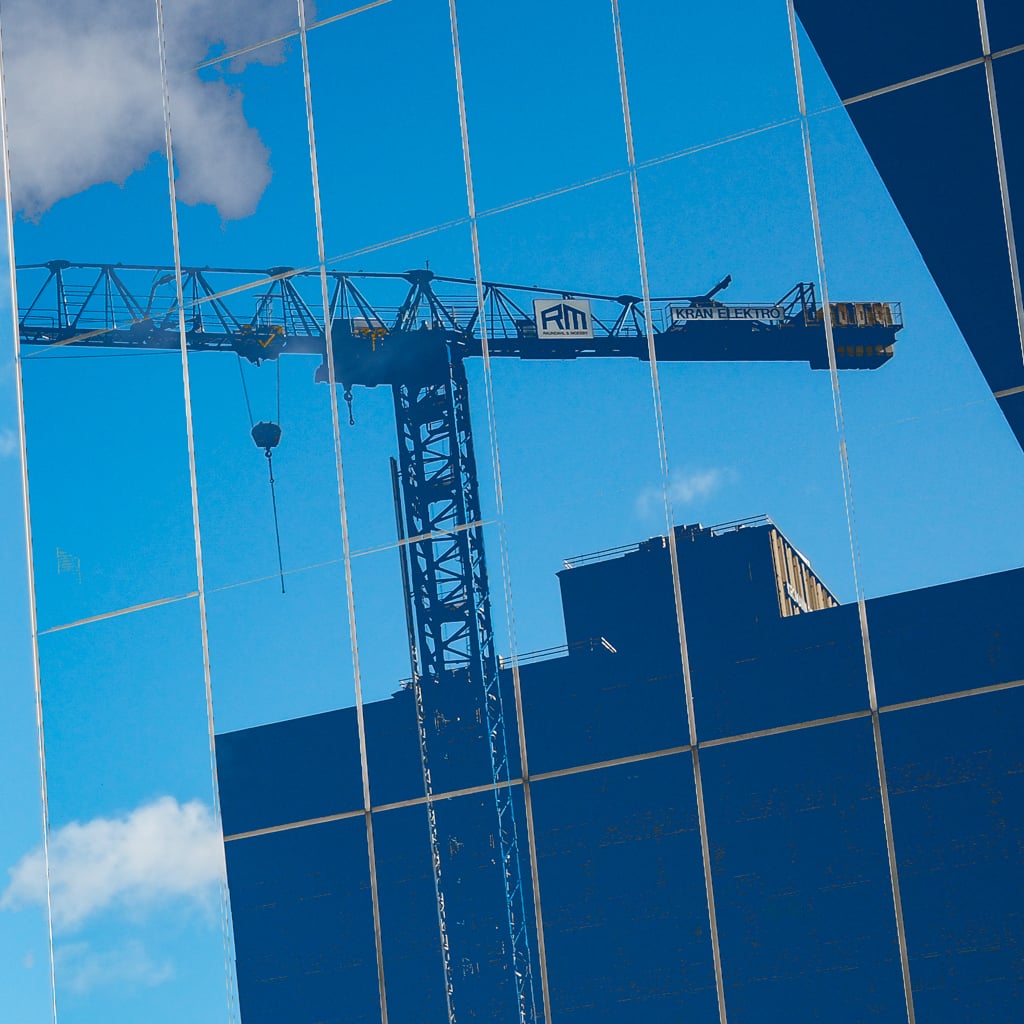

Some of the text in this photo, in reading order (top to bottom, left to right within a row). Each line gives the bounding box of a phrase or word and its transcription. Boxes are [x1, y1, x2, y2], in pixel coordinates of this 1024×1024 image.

[541, 303, 588, 330] RM
[676, 308, 780, 319] KRAN ELEKTRO
